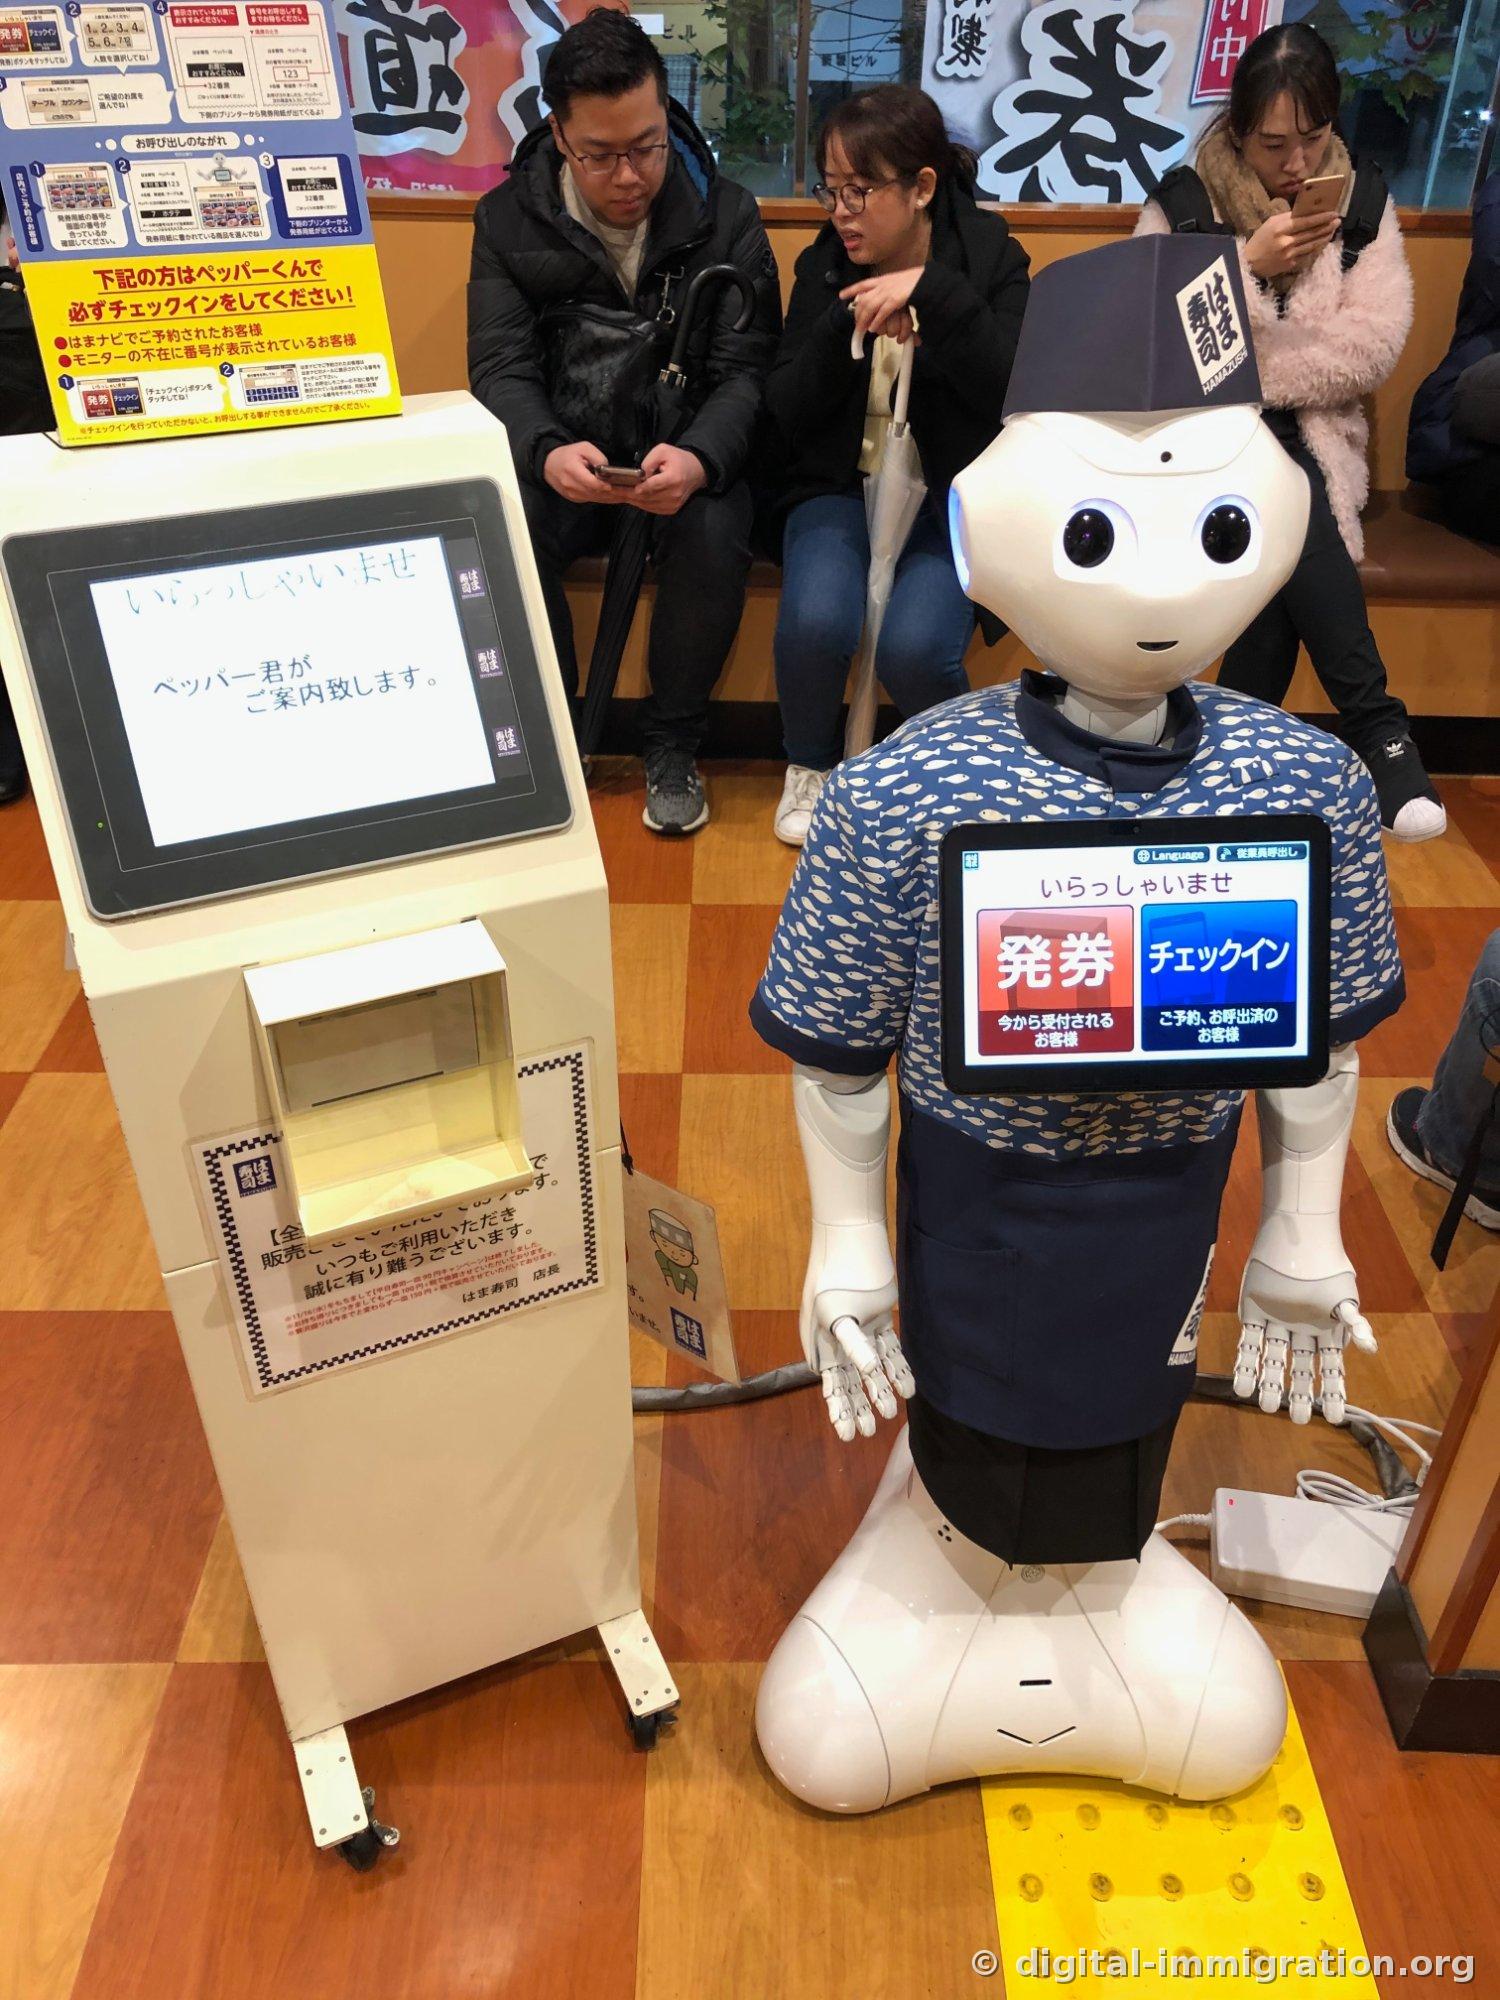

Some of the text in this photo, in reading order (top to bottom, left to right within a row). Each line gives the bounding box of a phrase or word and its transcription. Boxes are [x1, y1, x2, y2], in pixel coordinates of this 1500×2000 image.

[282, 69, 299, 79] 123
[136, 135, 228, 149] お呼び出しのながれ
[93, 259, 324, 290] 下記の方はペッパーくんで
[153, 654, 313, 697] ペッパー君が
[247, 664, 437, 714] ご案内致します。
[1152, 850, 1205, 862] Language
[1040, 872, 1233, 899] いらっしゃいませ
[996, 931, 1115, 990] 発券
[1148, 936, 1290, 974] チェックイン
[997, 1012, 1114, 1031] 今から受付される
[1159, 1007, 1279, 1028] ご予約、お呼出済の
[1034, 1031, 1078, 1049] お客様
[1197, 1027, 1240, 1044] お客様
[316, 1206, 517, 1276] いつもご利用いただき
[303, 1223, 533, 1300] 誠に有り難うございます。
[462, 1263, 561, 1304] はま寿司 店長
